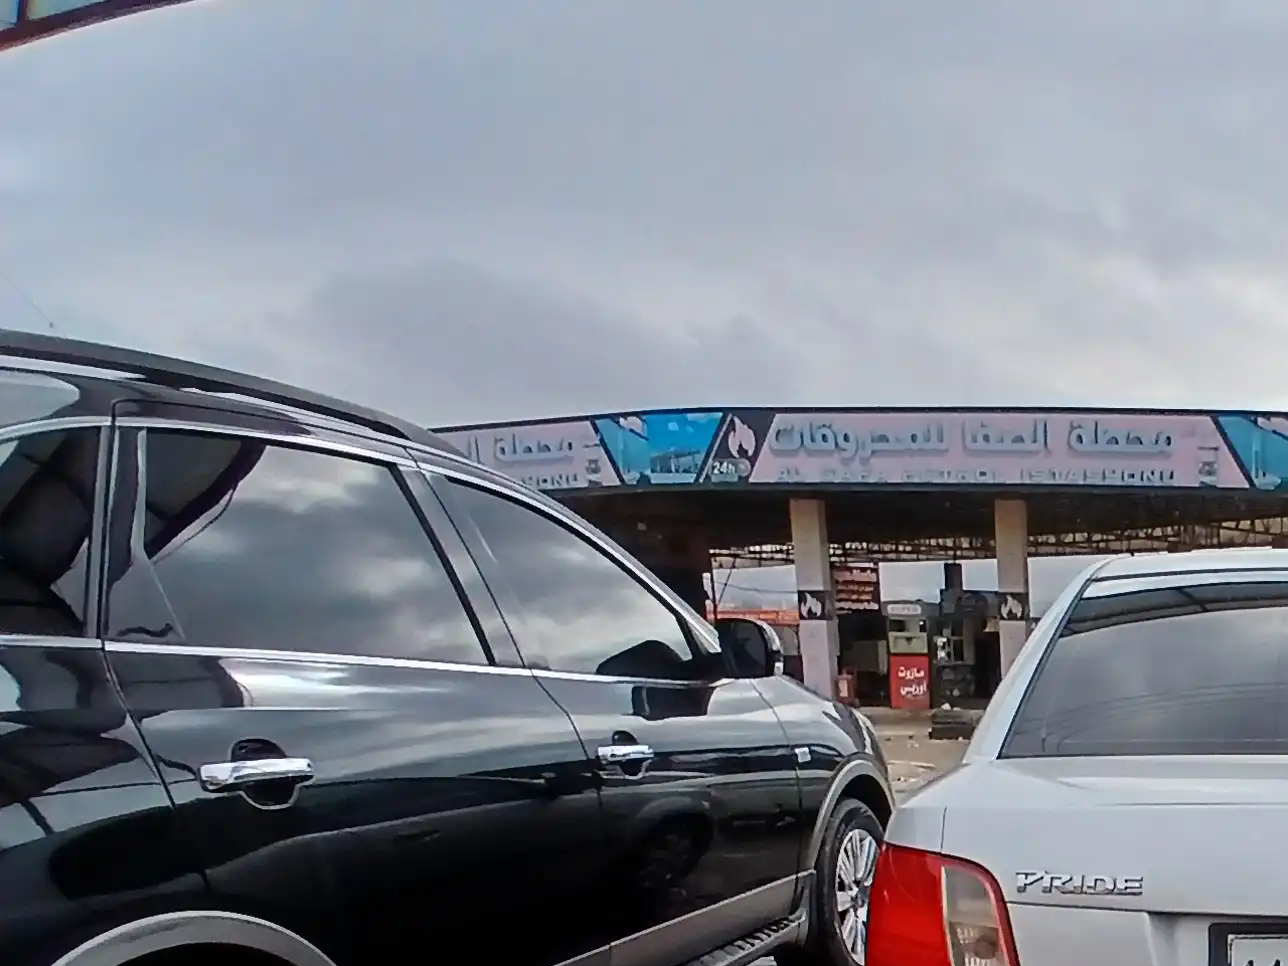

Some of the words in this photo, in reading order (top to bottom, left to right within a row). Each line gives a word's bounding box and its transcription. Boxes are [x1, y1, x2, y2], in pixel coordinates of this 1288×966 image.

[770, 420, 950, 464] للمحروقات
[962, 419, 1049, 453] الصفا
[1068, 419, 1174, 454] محطة
[712, 460, 736, 475] 24h
[1015, 869, 1144, 896] PRIDE
